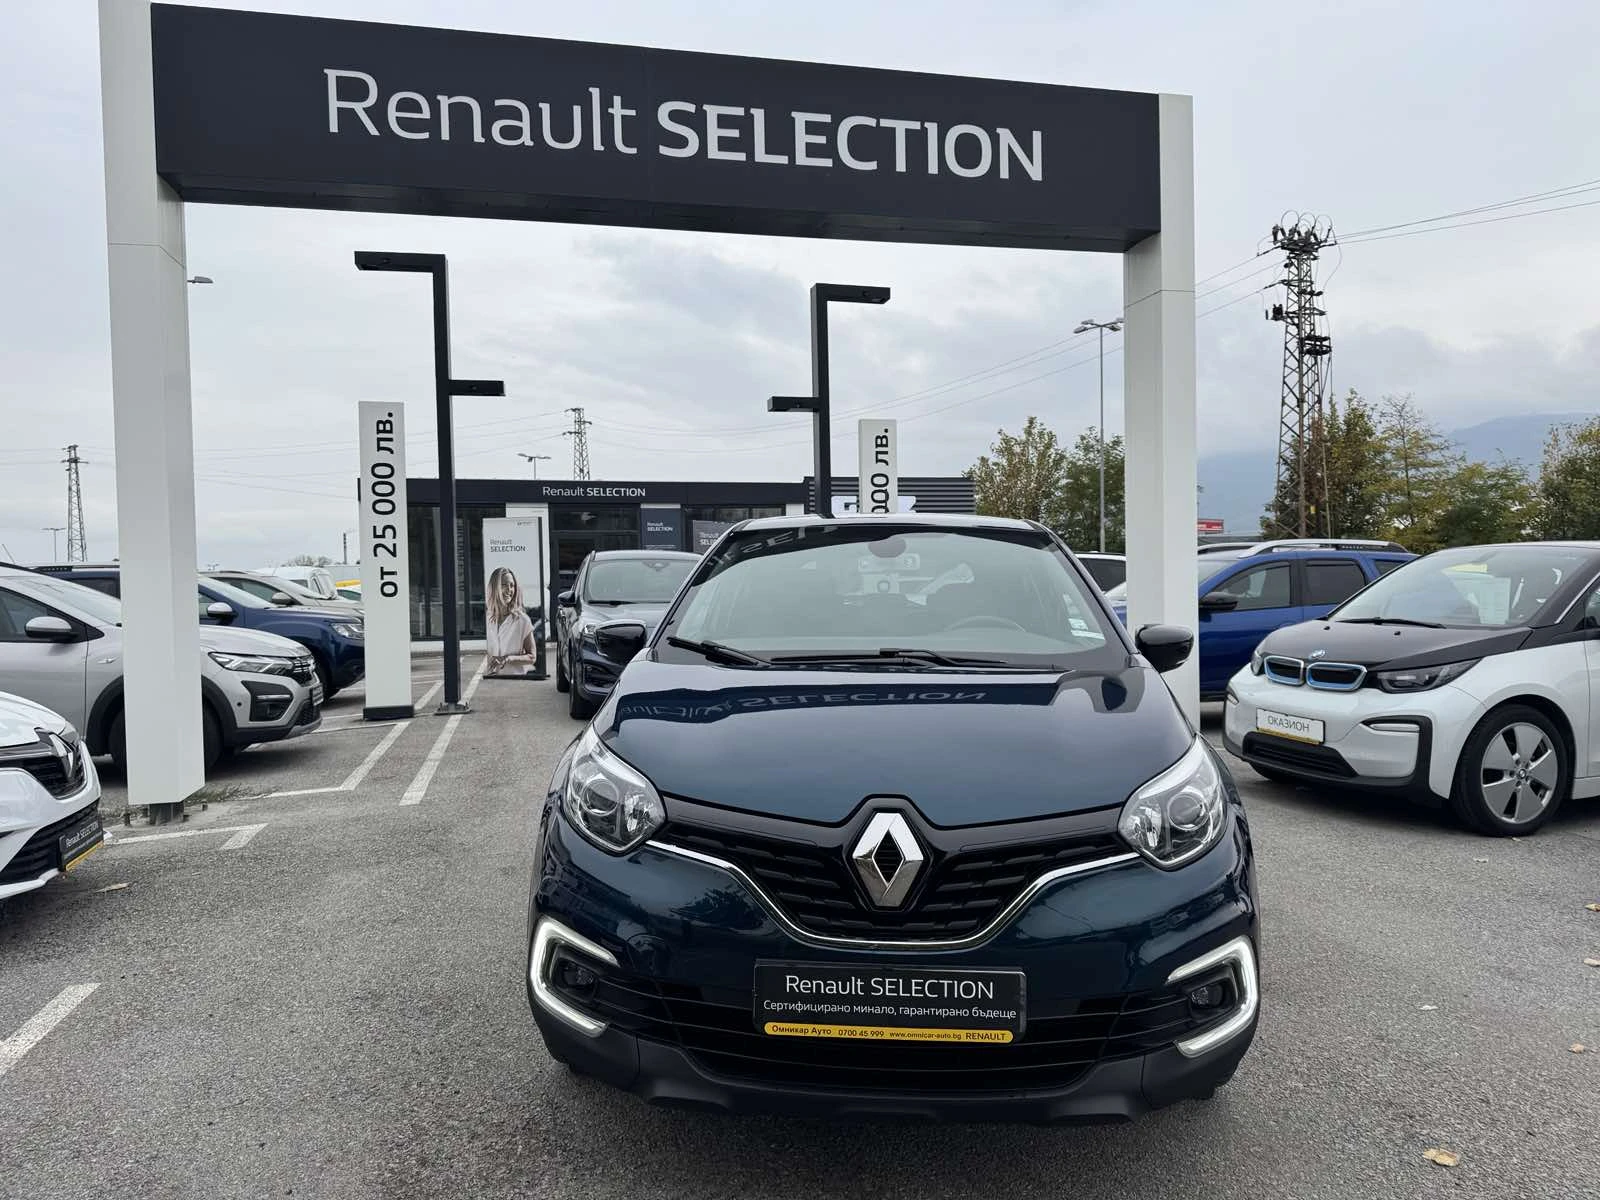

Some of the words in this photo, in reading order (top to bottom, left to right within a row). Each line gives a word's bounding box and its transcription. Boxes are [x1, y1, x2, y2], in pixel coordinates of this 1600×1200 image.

[324, 68, 638, 154] Renault
[658, 100, 1043, 181] SELECTION
[376, 412, 394, 455] лв.
[875, 428, 889, 466] лв.
[371, 462, 396, 516] 000
[542, 486, 585, 497] Renault
[586, 487, 646, 497] SELECTION
[373, 525, 397, 558] 25
[380, 566, 398, 598] от
[1267, 715, 1310, 733] ОКАЗИОН
[785, 975, 865, 996] Renault
[871, 977, 994, 999] SELECTION
[763, 1000, 851, 1013] Сертифицирано
[853, 1004, 897, 1015] минало,
[899, 1006, 970, 1018] гарантирано
[972, 1007, 1017, 1019] бъдеще
[771, 1025, 809, 1035] Омникар
[811, 1027, 832, 1036] Ауто
[838, 1029, 858, 1037] 0700
[870, 1030, 885, 1038] 999
[889, 1031, 962, 1040] www.omnicar-auto.bg
[965, 1032, 1006, 1041] RENAULT
